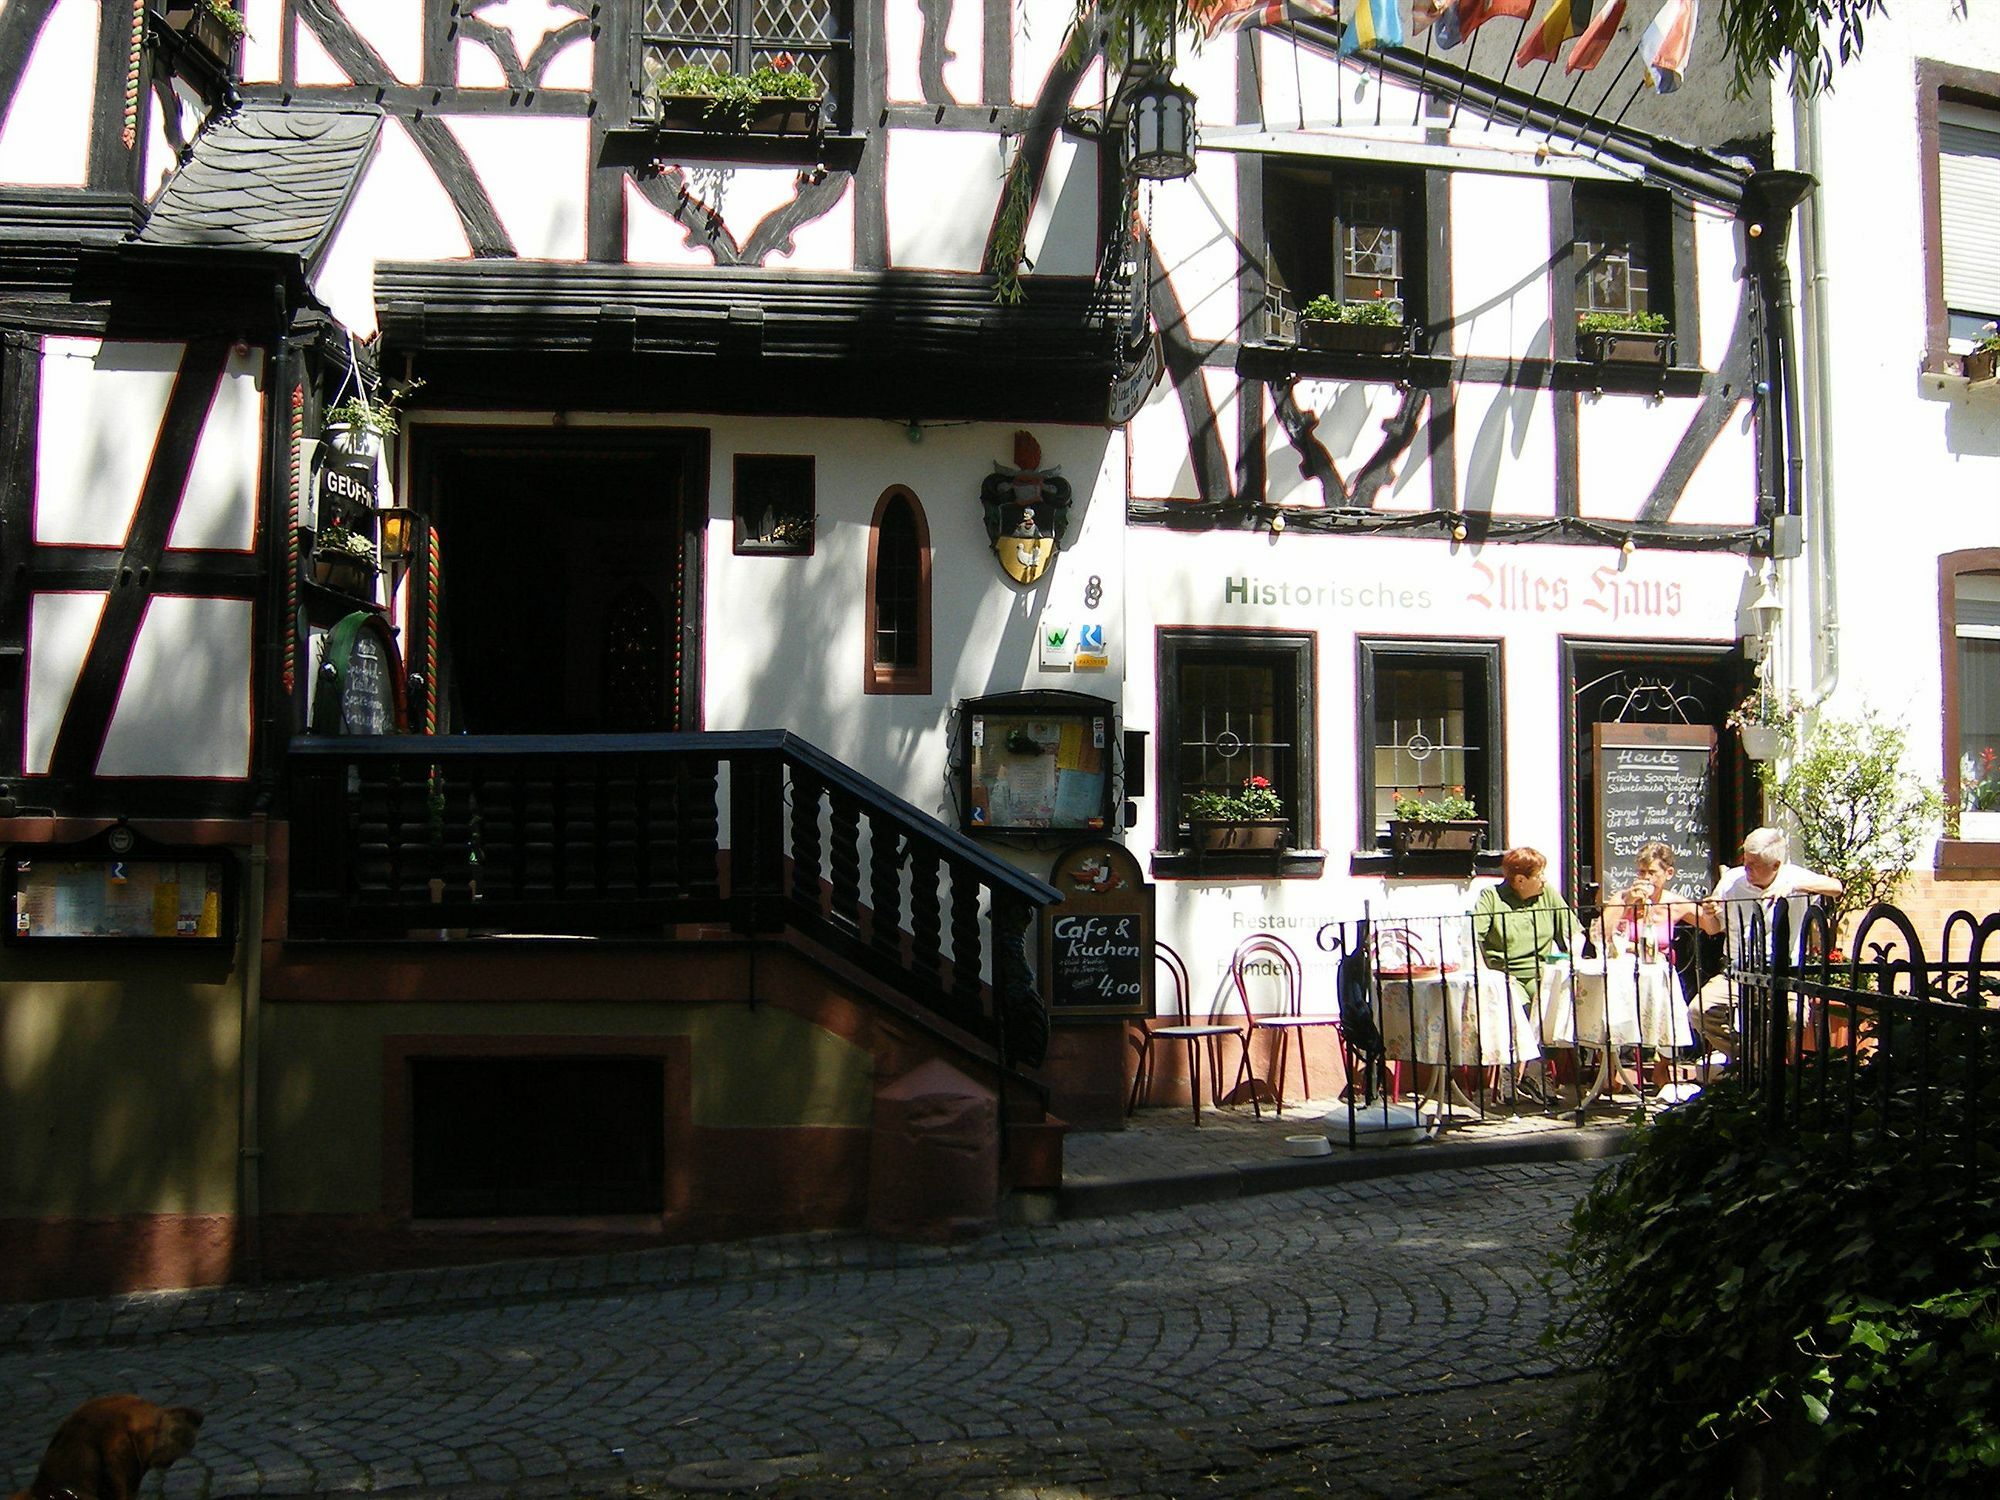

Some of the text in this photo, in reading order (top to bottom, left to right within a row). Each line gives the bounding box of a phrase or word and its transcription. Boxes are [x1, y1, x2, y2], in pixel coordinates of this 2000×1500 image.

[1084, 574, 1103, 610] 8
[1225, 560, 1682, 622] Historisches Altes Haus
[1617, 749, 1679, 764] Heute
[1650, 832, 1668, 842] mit
[1115, 918, 1131, 939] &
[1067, 939, 1140, 957] Kuchen
